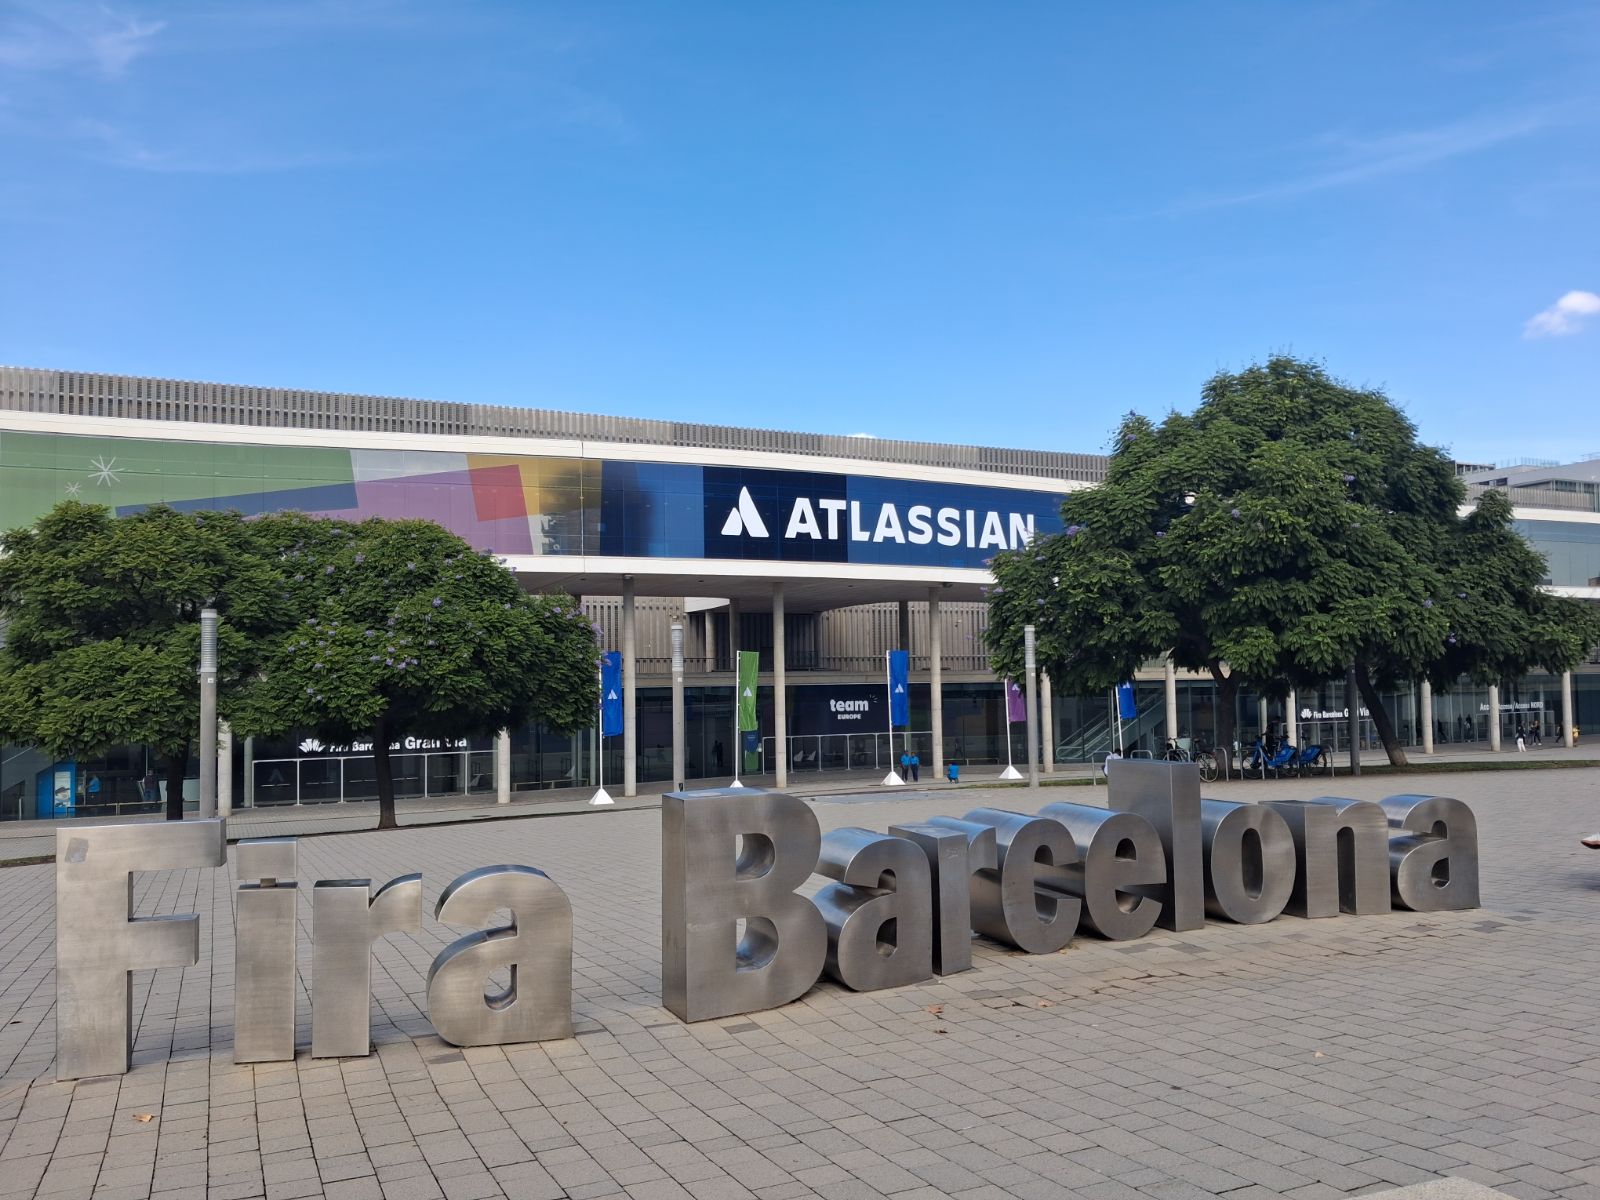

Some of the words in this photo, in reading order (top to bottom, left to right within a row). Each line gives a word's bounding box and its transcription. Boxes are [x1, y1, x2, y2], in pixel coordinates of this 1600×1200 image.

[784, 497, 1035, 551] ATLASSIAN
[830, 699, 869, 712] team
[56, 817, 575, 1081] Fira
[662, 758, 1481, 1024] Barcelona
